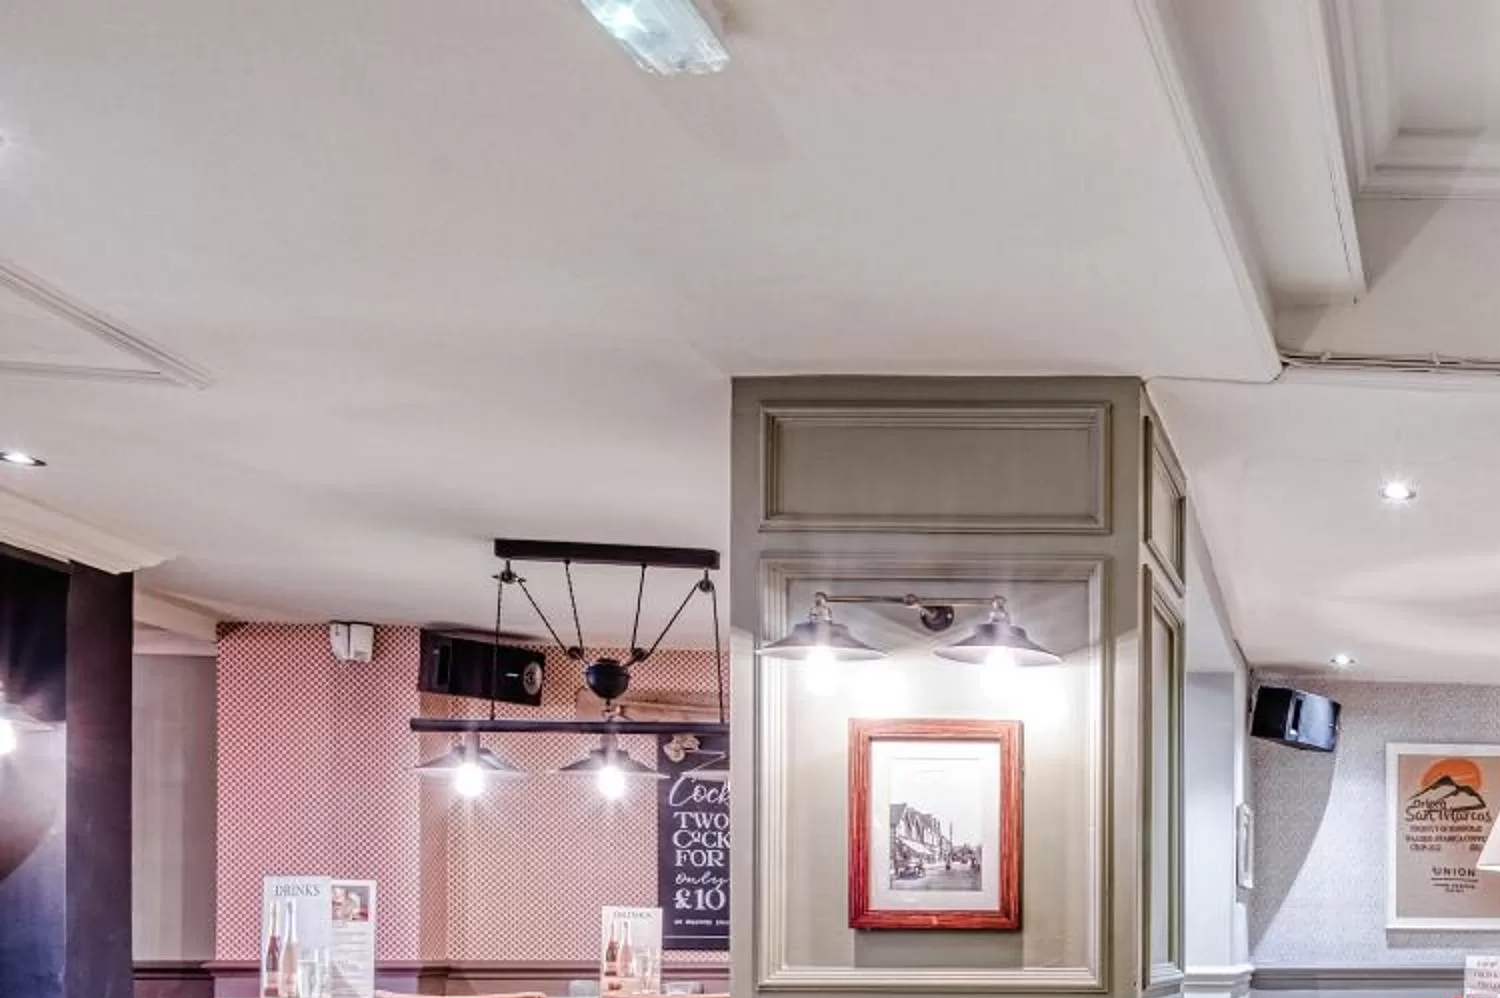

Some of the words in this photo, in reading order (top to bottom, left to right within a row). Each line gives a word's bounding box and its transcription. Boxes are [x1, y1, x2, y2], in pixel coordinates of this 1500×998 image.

[672, 811, 729, 830] TWO
[1405, 805, 1436, 822] San
[1439, 806, 1493, 823] Marcos
[674, 849, 725, 867] FOR
[1431, 866, 1476, 877] UNION
[274, 884, 321, 897] DRINKS
[673, 887, 727, 911] £10
